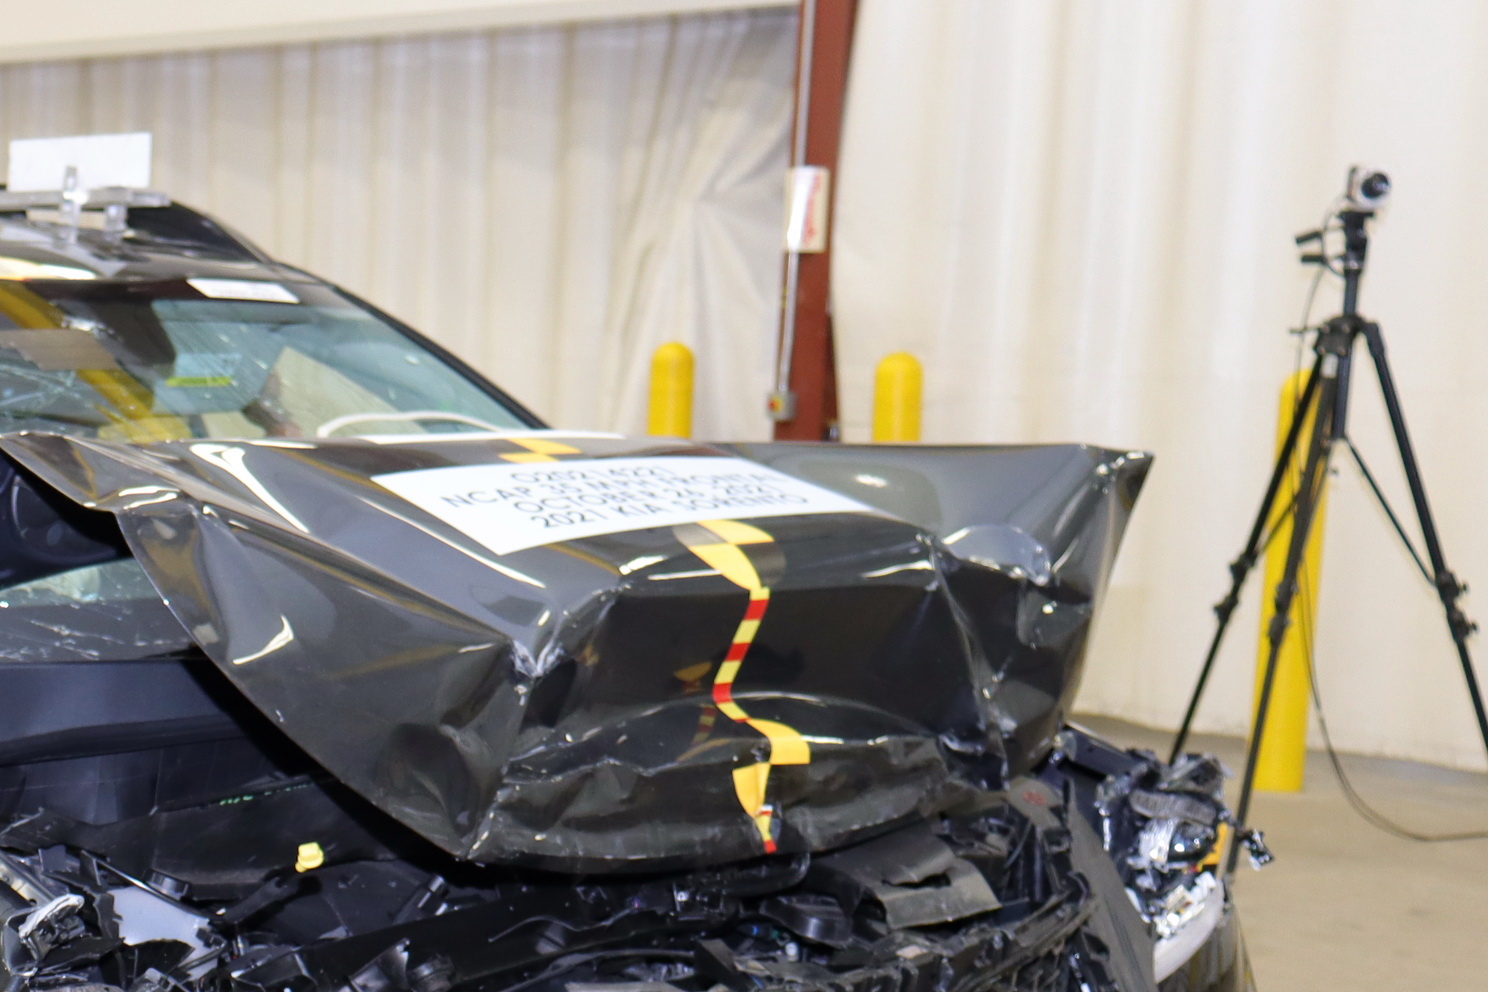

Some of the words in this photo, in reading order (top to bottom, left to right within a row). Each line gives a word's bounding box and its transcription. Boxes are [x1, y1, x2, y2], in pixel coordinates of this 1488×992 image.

[440, 486, 533, 508] NCAP
[539, 483, 583, 494] 35
[514, 489, 665, 513] OCTOBER
[531, 508, 608, 528] 2021
[610, 502, 673, 517] KIA
